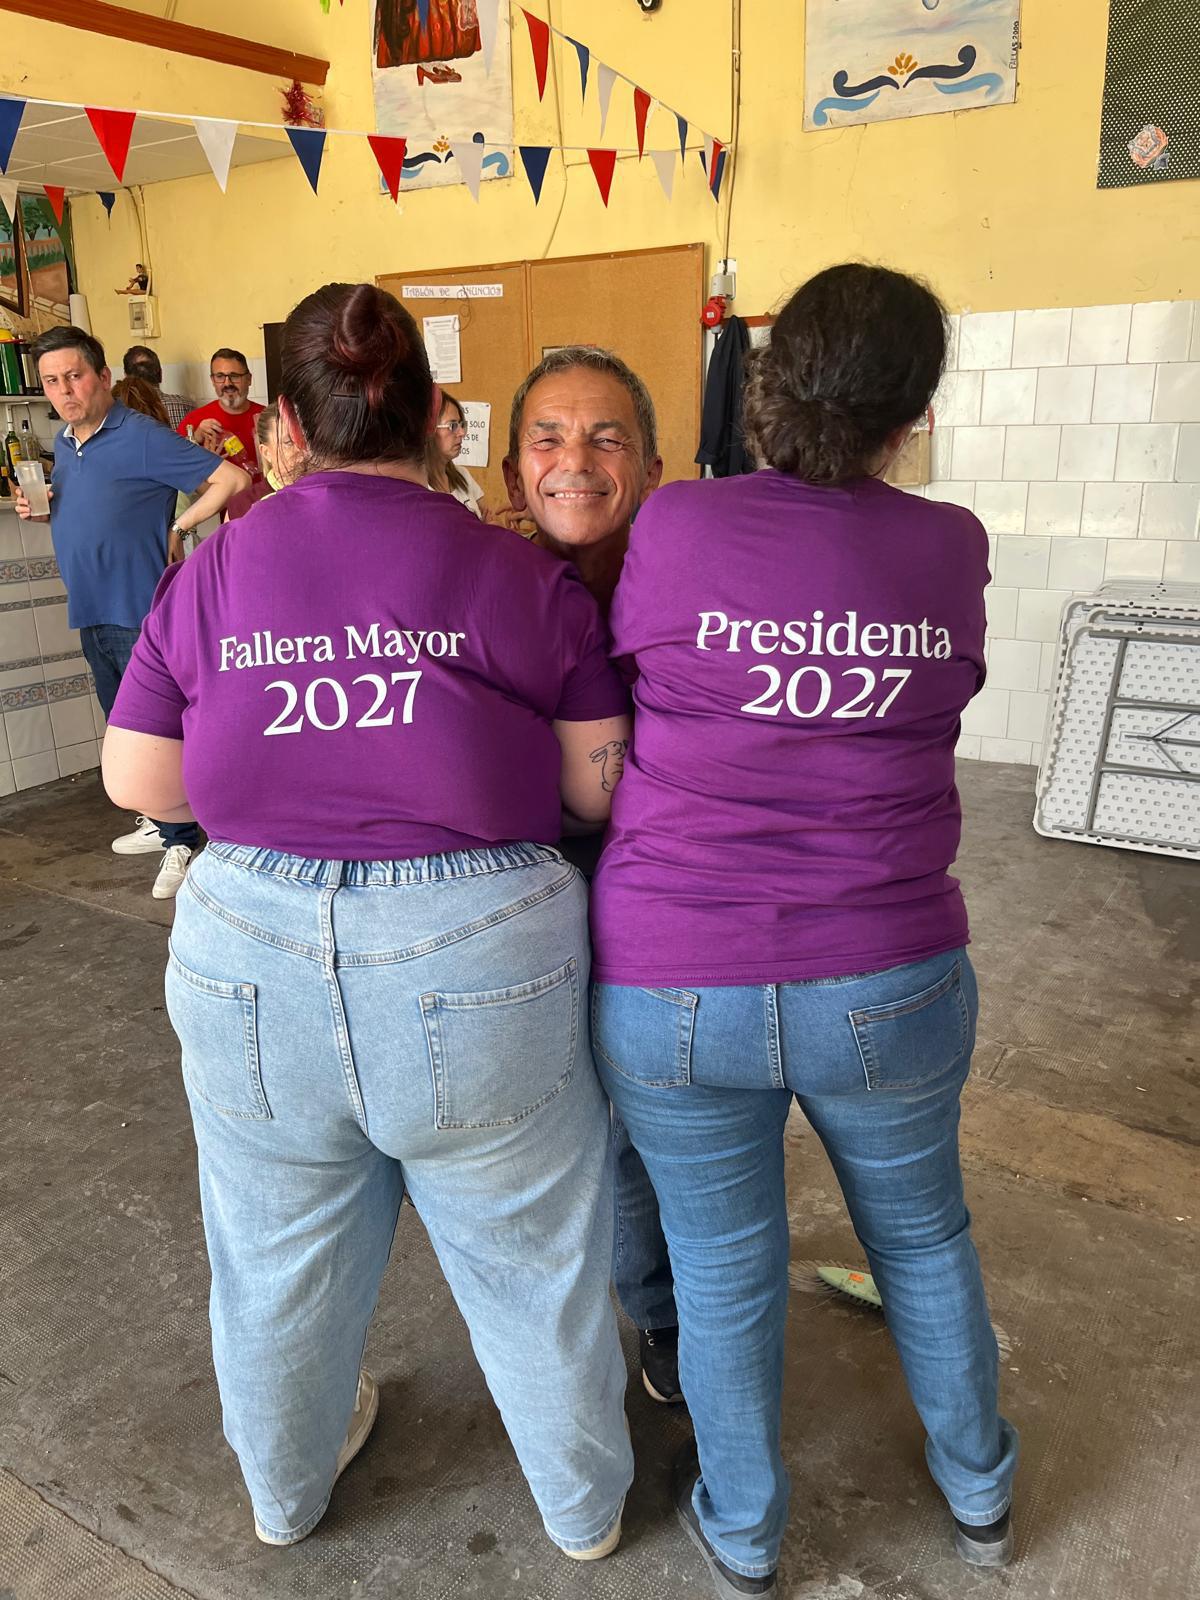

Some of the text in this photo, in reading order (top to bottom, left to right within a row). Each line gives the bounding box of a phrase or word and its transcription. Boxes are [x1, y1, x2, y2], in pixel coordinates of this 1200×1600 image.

[1009, 42, 1018, 70] FALLAS
[439, 287, 450, 297] DE
[469, 420, 486, 429] SOLO
[471, 434, 479, 442] DE
[218, 622, 466, 672] Fallera Mayor
[696, 610, 952, 661] Presidenta
[263, 671, 423, 736] 2027
[741, 665, 913, 719] 2027
